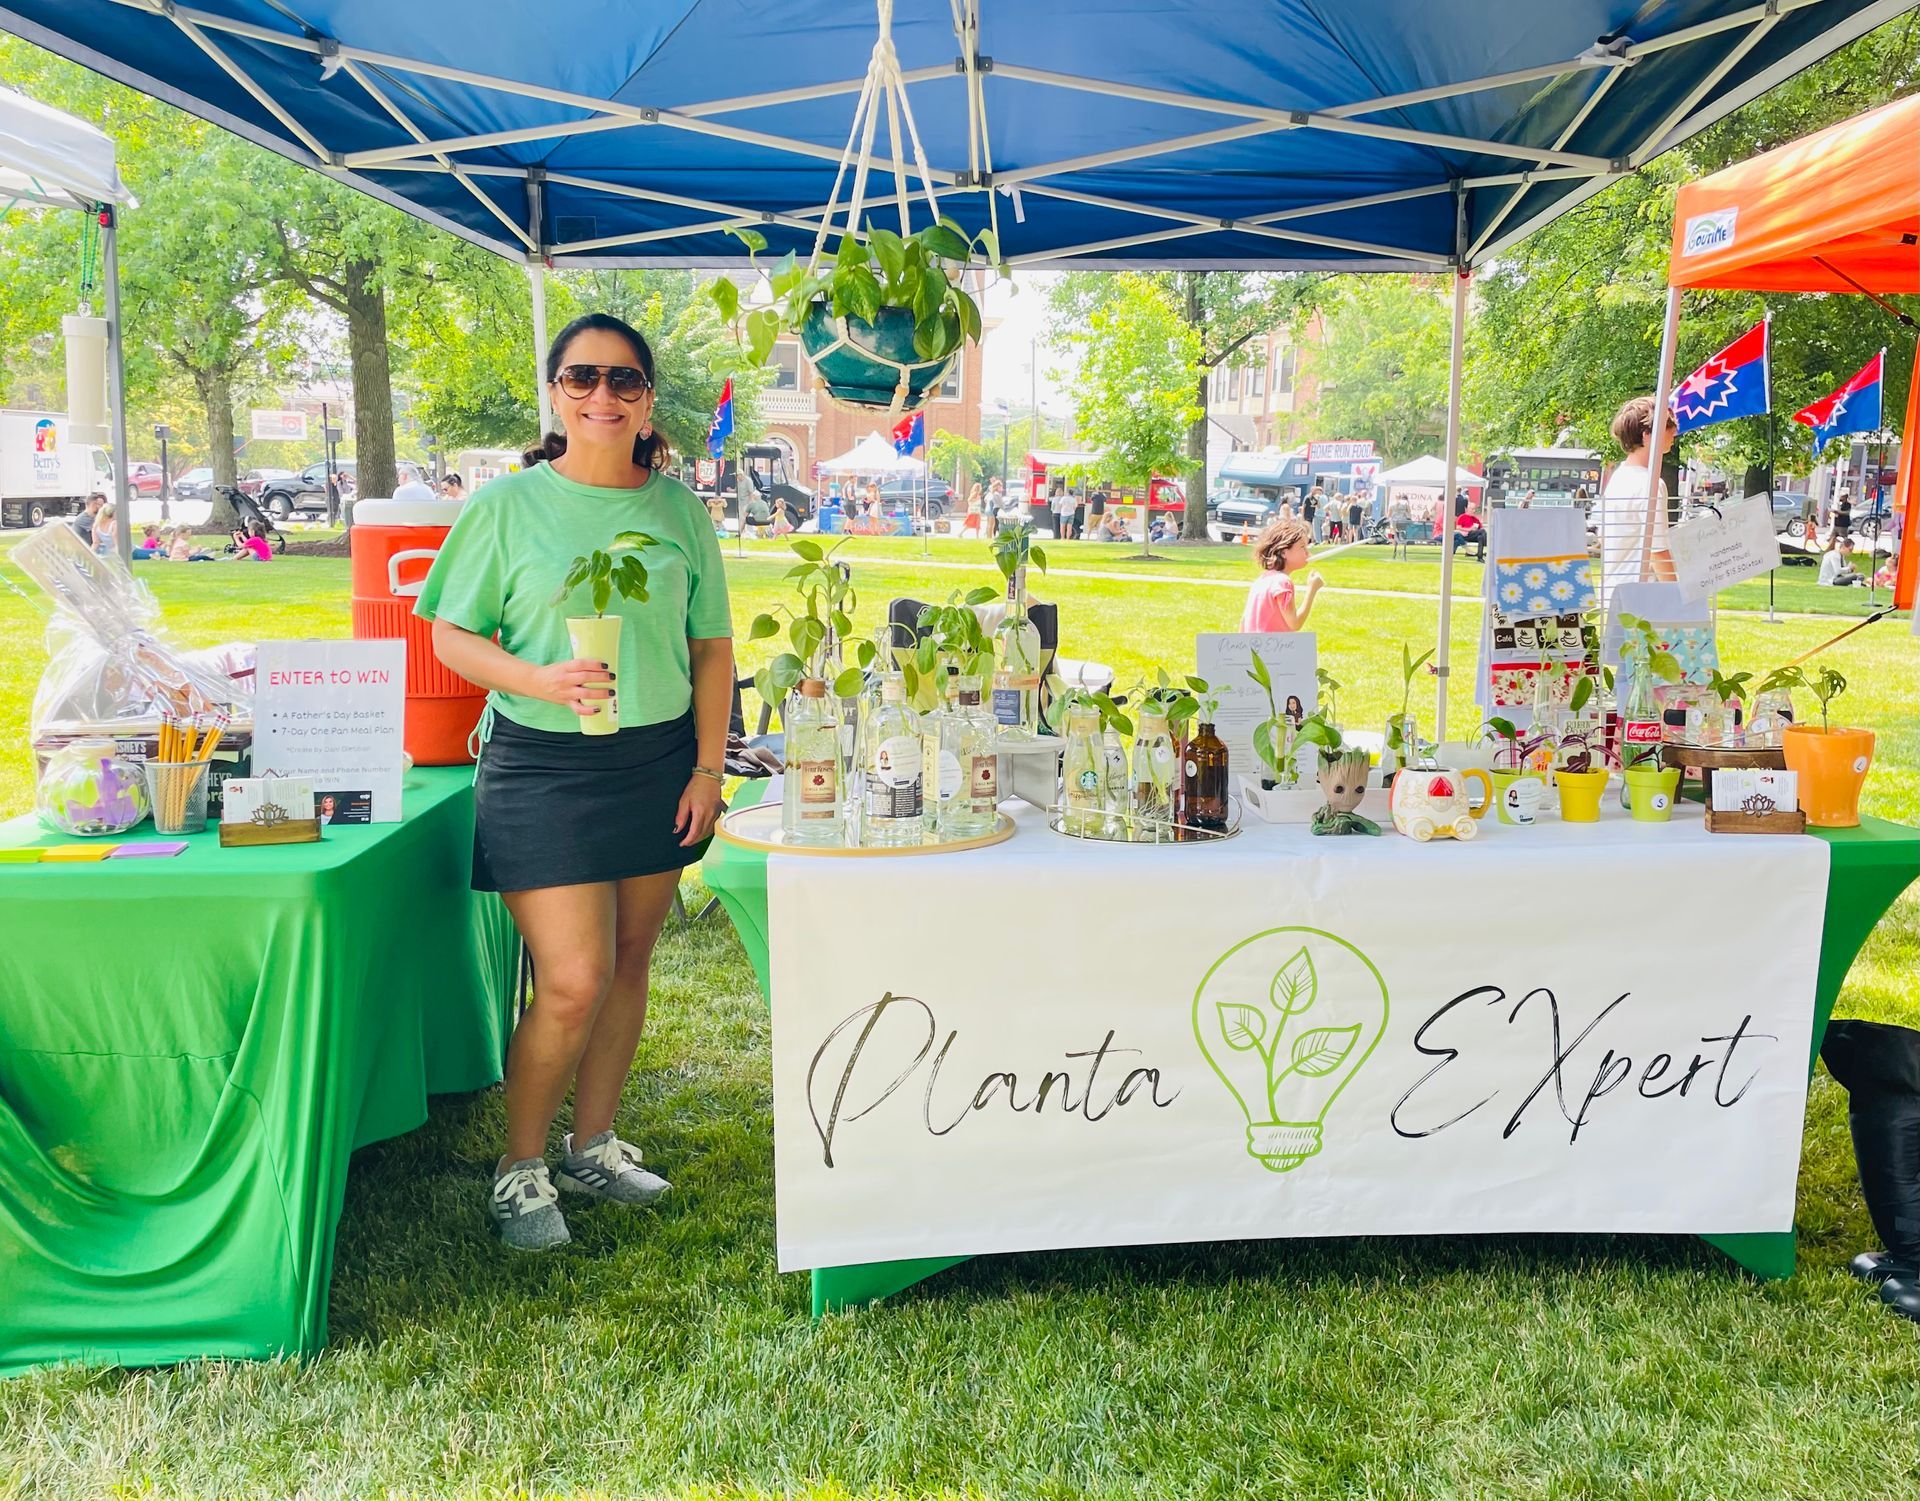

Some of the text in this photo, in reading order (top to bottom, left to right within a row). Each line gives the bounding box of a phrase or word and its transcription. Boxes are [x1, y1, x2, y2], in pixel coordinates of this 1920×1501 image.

[1311, 444, 1371, 459] HOME RUN FOOD
[33, 453, 61, 470] Berry's
[1708, 557, 1732, 572] Kitchen
[1496, 634, 1513, 643] Café
[270, 671, 324, 685] ENTER
[357, 669, 390, 683] WIN
[282, 710, 385, 721] A Father's Day Basket
[282, 726, 394, 736] 7-Day One Pan Meal Plan
[115, 741, 147, 754] SHEY'S
[1656, 798, 1664, 808] S
[807, 984, 1778, 1168] Planta EXpert
